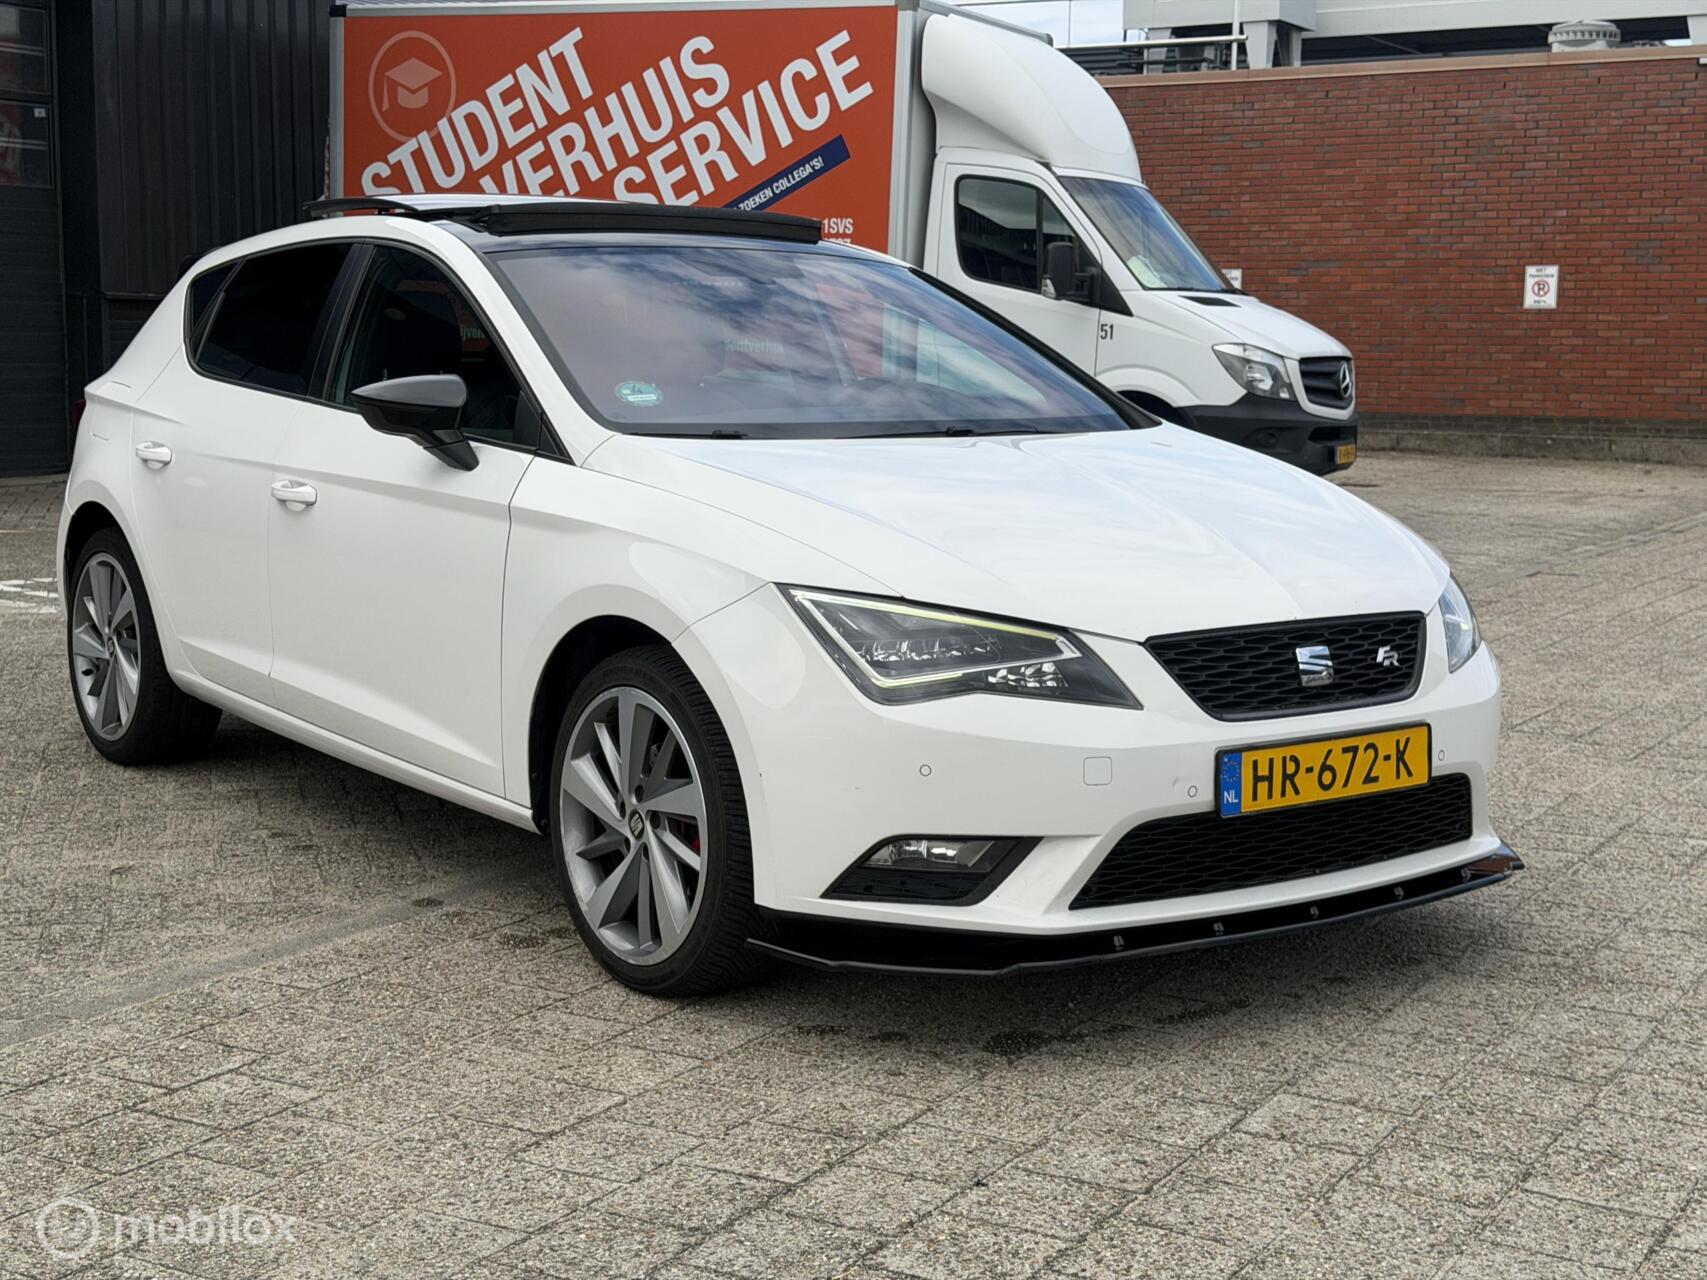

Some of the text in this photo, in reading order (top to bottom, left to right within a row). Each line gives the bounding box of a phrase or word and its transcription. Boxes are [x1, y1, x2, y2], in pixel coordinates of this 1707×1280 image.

[613, 29, 874, 207] SERVICE
[772, 155, 825, 195] COLLEGA'S!
[1100, 323, 1114, 340] 51
[1251, 736, 1414, 802] HR-672-K
[1223, 789, 1239, 804] NL
